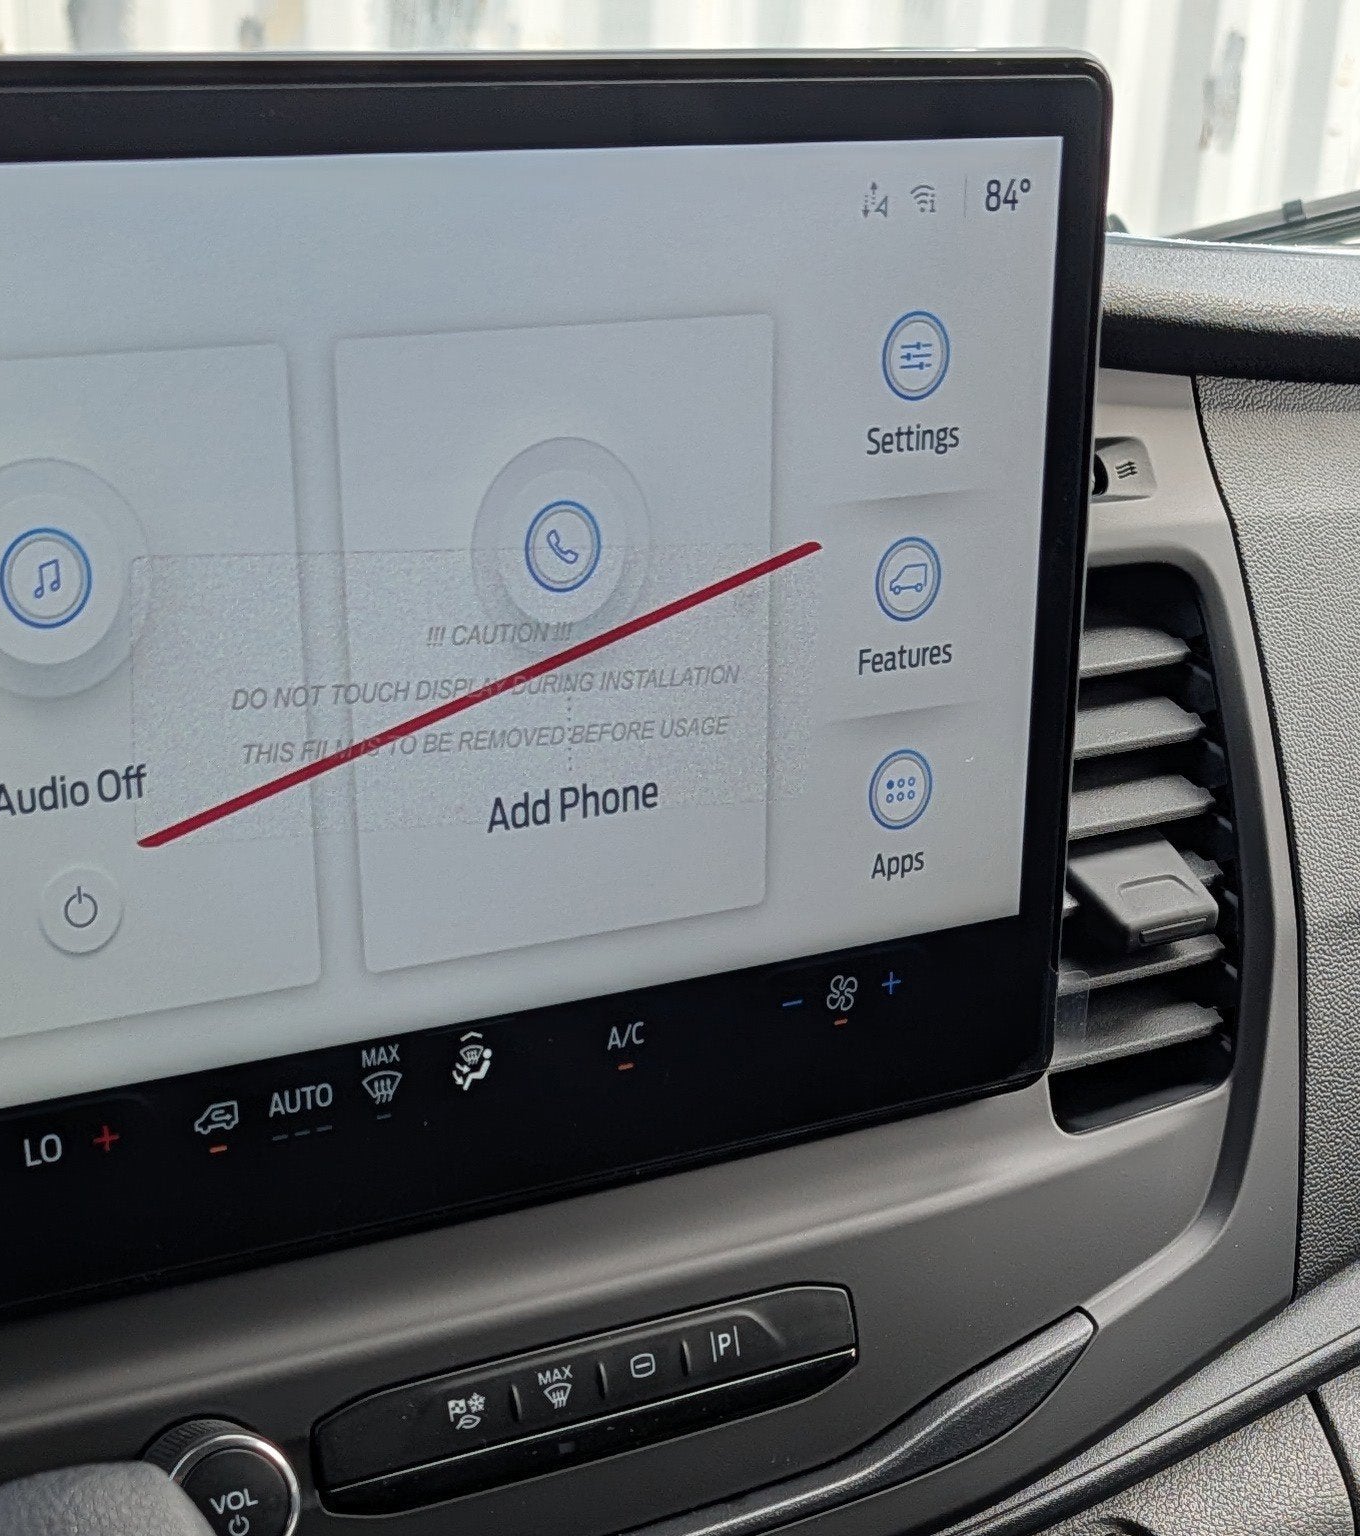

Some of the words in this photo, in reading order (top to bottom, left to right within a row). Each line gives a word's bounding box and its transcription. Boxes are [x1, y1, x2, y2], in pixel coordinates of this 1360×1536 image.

[984, 177, 1032, 212] 84°
[866, 423, 960, 456] Settings
[451, 622, 549, 647] CAUTION
[858, 642, 953, 675] Features
[232, 687, 268, 711] DO
[274, 684, 327, 708] NOT
[332, 680, 410, 706] TOUCH
[510, 671, 593, 696] DURING
[599, 665, 740, 692] INSTALLATION
[242, 742, 296, 765] THIS
[388, 734, 418, 757] TO
[422, 731, 454, 754] BE
[459, 725, 565, 751] REMOVED
[569, 720, 656, 745] BEFORE
[660, 716, 731, 740] USAGE
[97, 763, 148, 803] Off
[487, 788, 551, 834] Add
[559, 782, 659, 823] Phone
[871, 849, 925, 882] Apps
[607, 1021, 645, 1051] A/C
[361, 1043, 401, 1069] MAX
[268, 1083, 334, 1118] AUTO
[23, 1133, 63, 1168] LO
[537, 1364, 574, 1386] MAX
[209, 1488, 259, 1515] VOL
